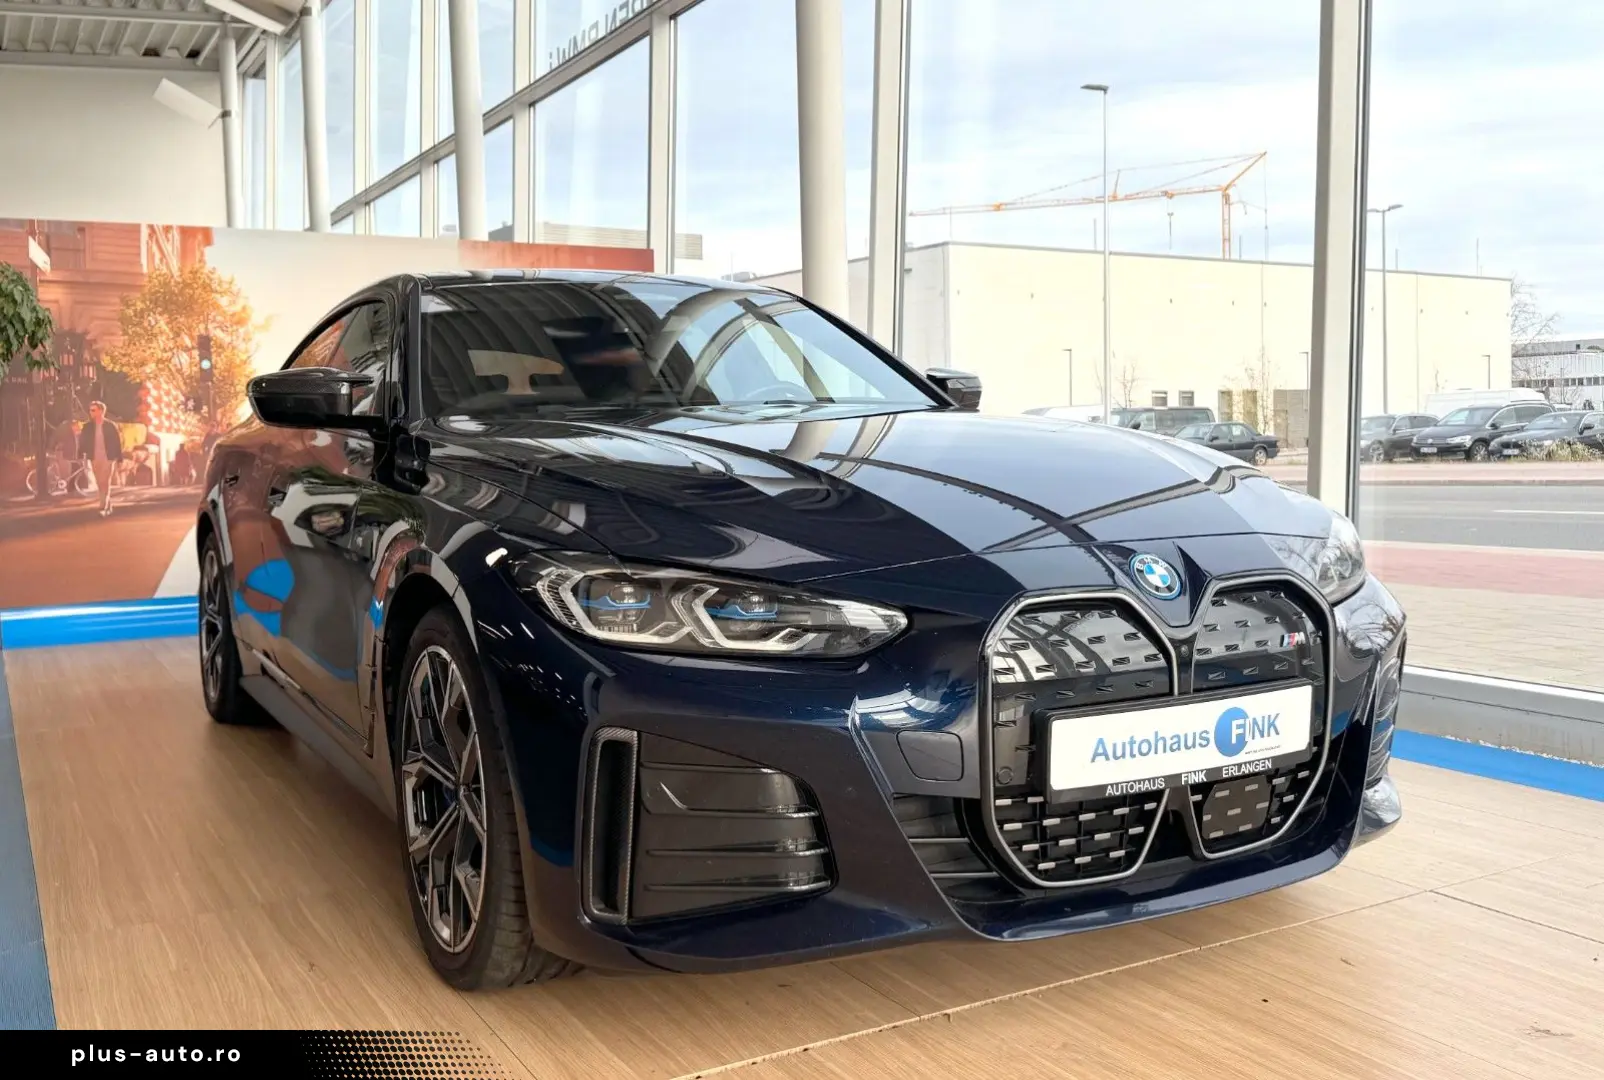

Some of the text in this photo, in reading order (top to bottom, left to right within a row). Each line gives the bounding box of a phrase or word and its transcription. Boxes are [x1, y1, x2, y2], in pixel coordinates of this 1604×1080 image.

[1136, 556, 1168, 570] BMW
[1091, 713, 1281, 763] Autohaus FINK
[1106, 758, 1272, 797] AUTOHAUS FINK ERLANGEN
